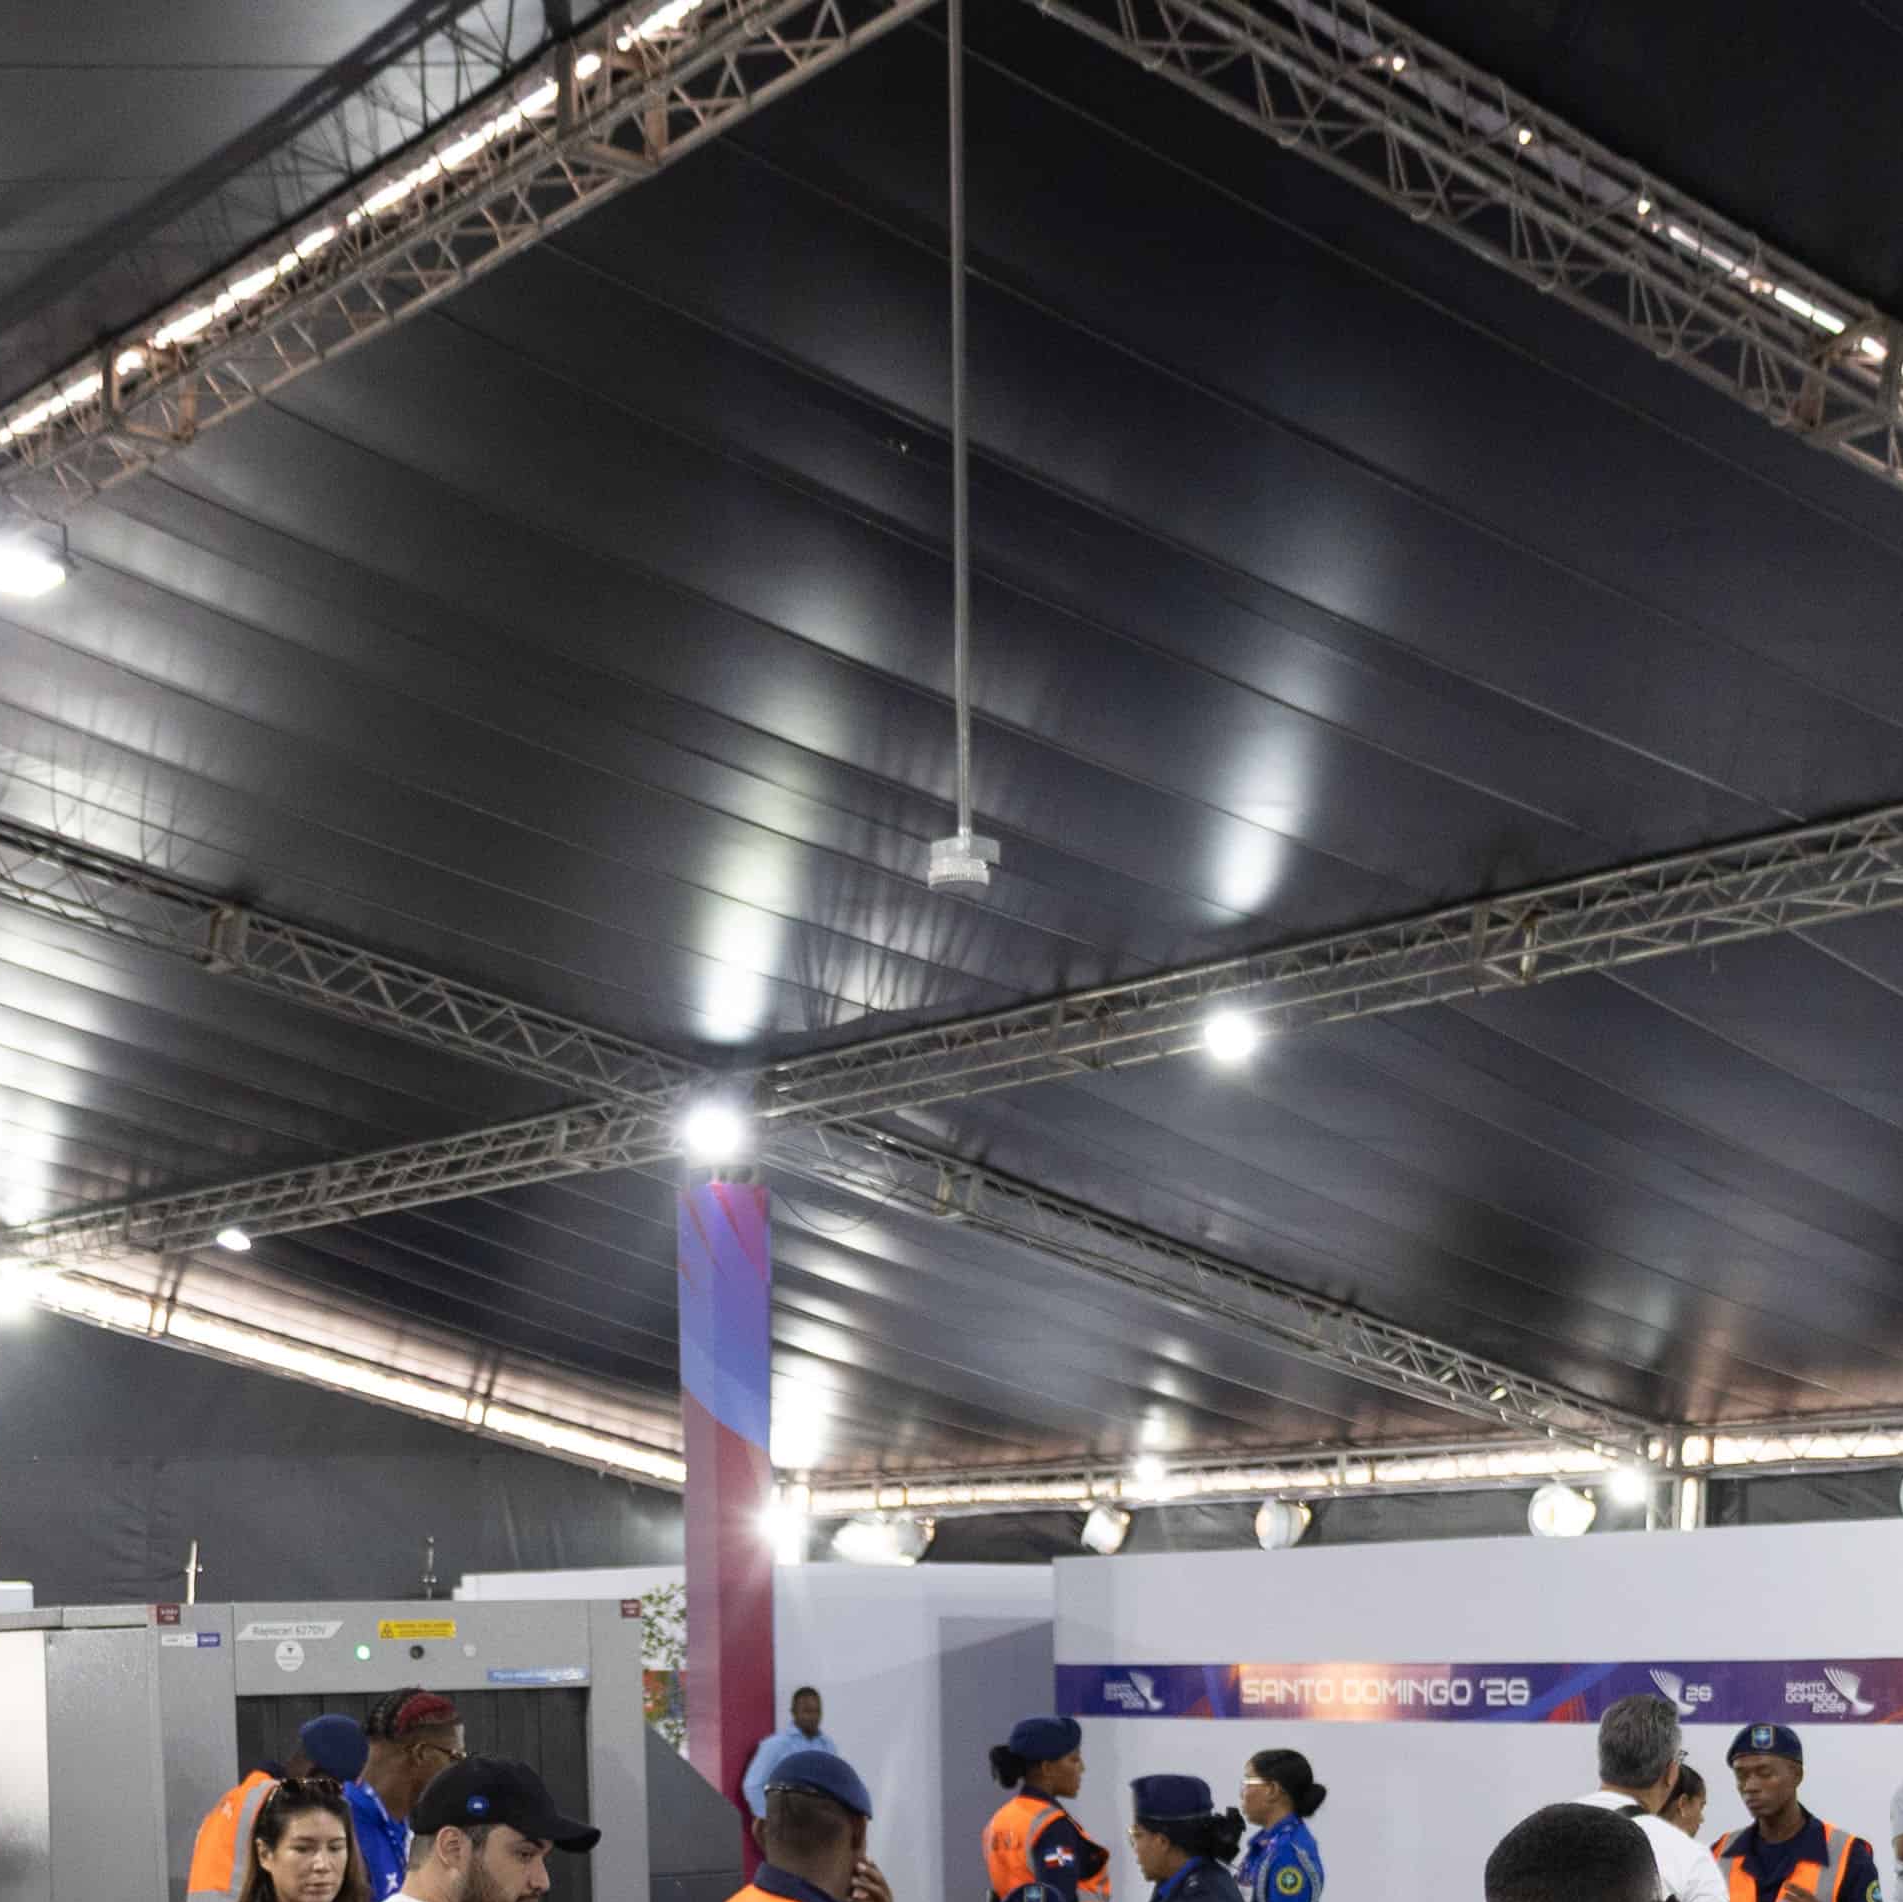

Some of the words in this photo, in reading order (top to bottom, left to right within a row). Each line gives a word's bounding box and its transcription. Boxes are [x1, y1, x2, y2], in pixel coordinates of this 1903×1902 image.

[1241, 1678, 1333, 1705] SANTO
[1342, 1678, 1472, 1706] DOMINGO
[1479, 1677, 1530, 1706] '26
